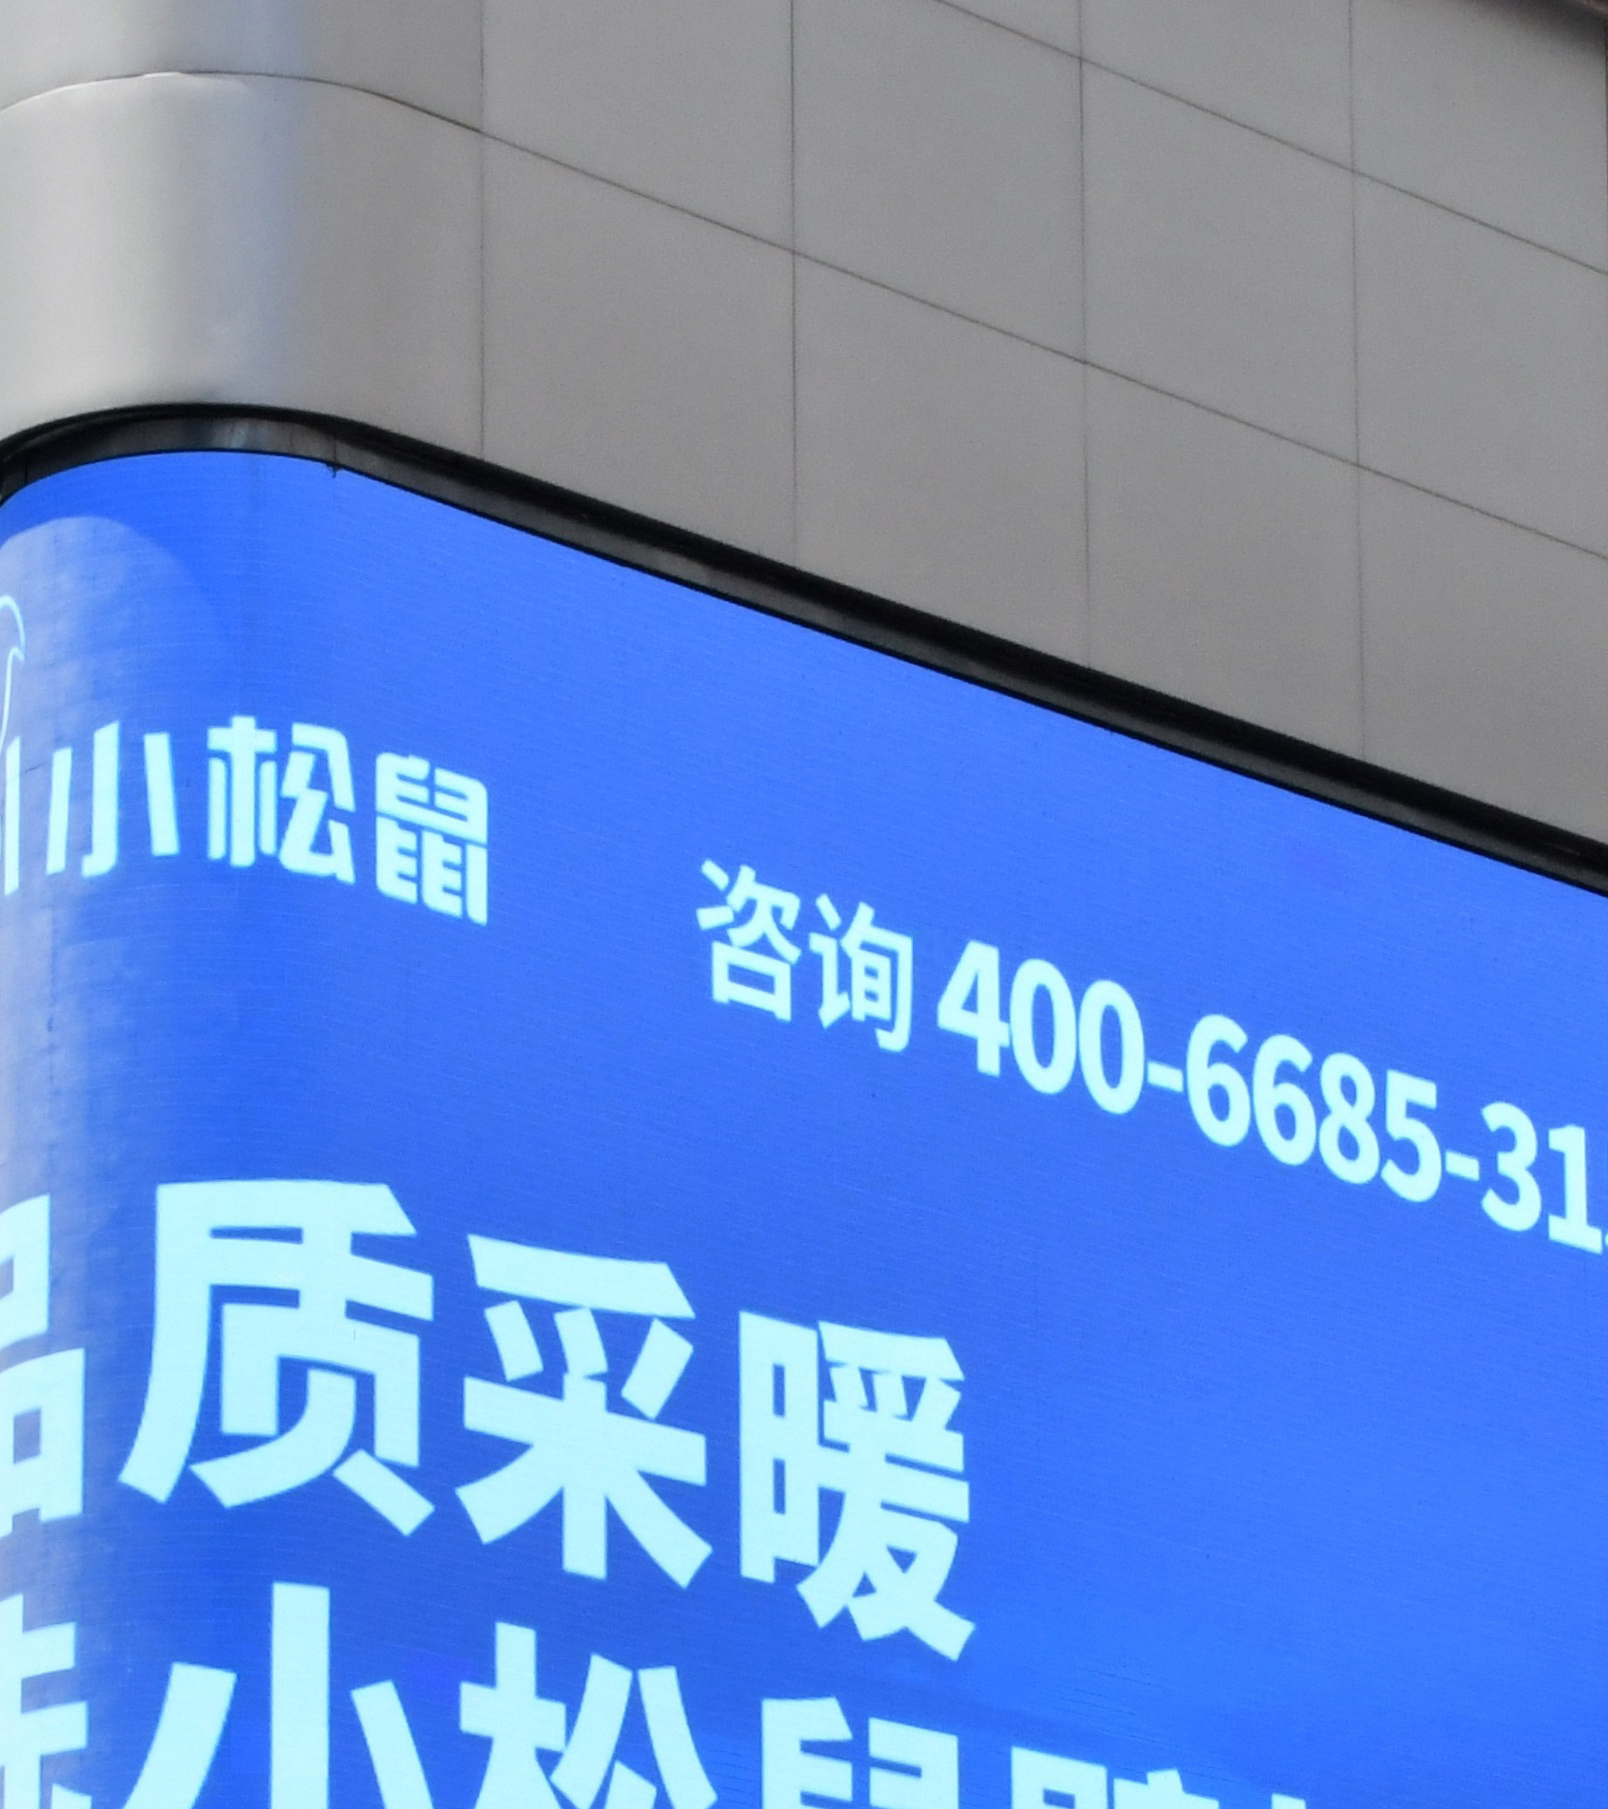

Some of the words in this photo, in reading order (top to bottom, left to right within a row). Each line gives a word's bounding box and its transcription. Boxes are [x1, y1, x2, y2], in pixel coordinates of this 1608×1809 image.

[46, 714, 489, 926] 小松鼠
[695, 860, 913, 1054] 咨询
